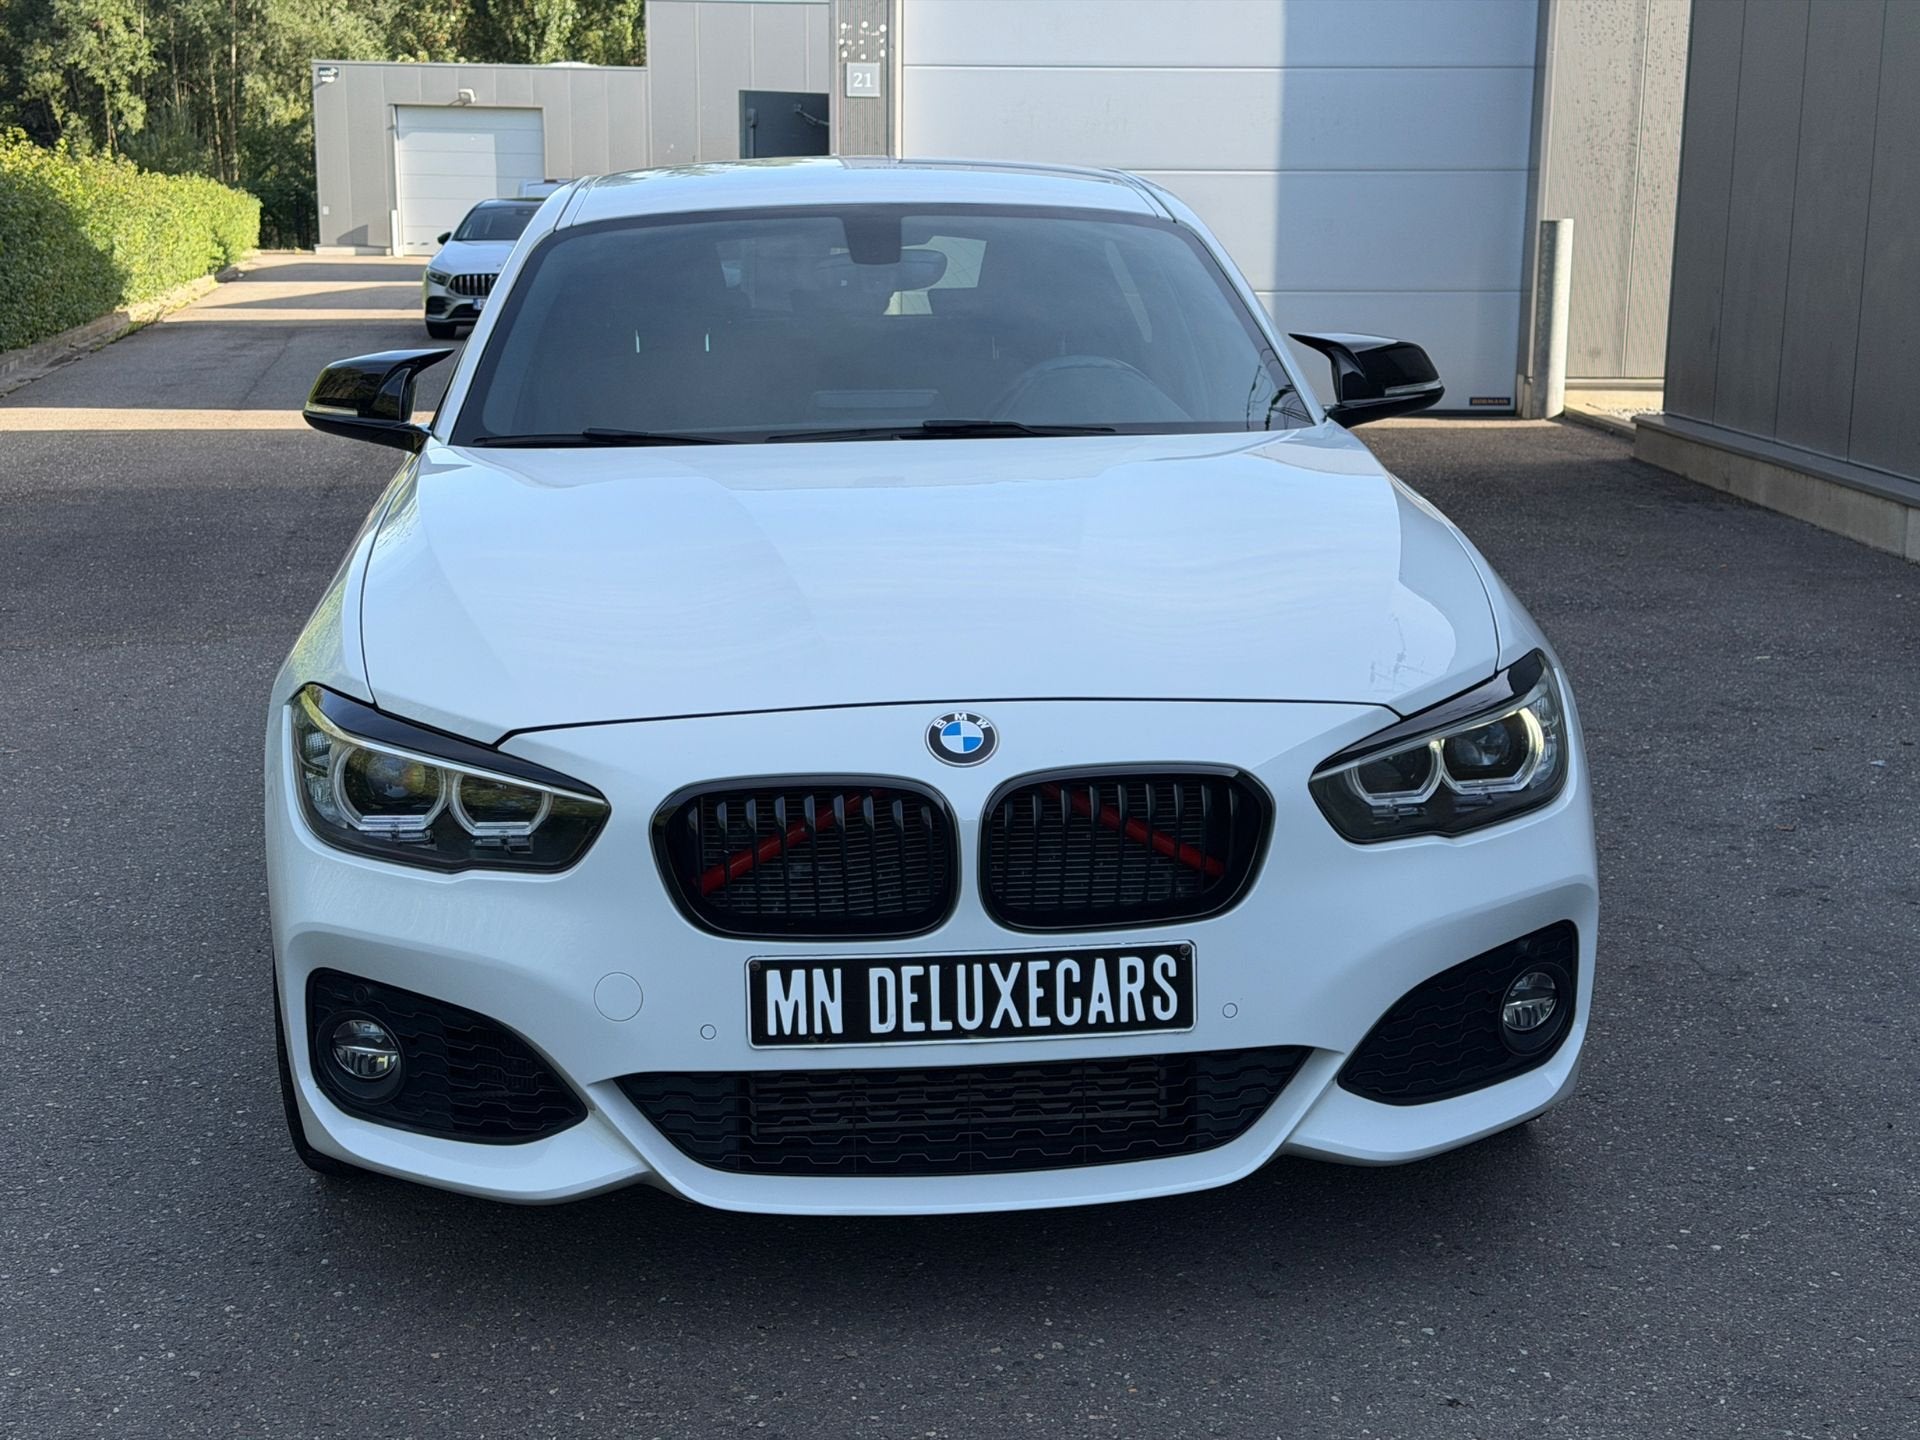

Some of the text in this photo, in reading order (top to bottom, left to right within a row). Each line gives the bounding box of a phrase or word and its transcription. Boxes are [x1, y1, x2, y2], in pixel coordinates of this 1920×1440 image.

[853, 72, 872, 88] 21
[933, 712, 991, 729] BMW
[766, 954, 1178, 1036] MN DELUXECARS
